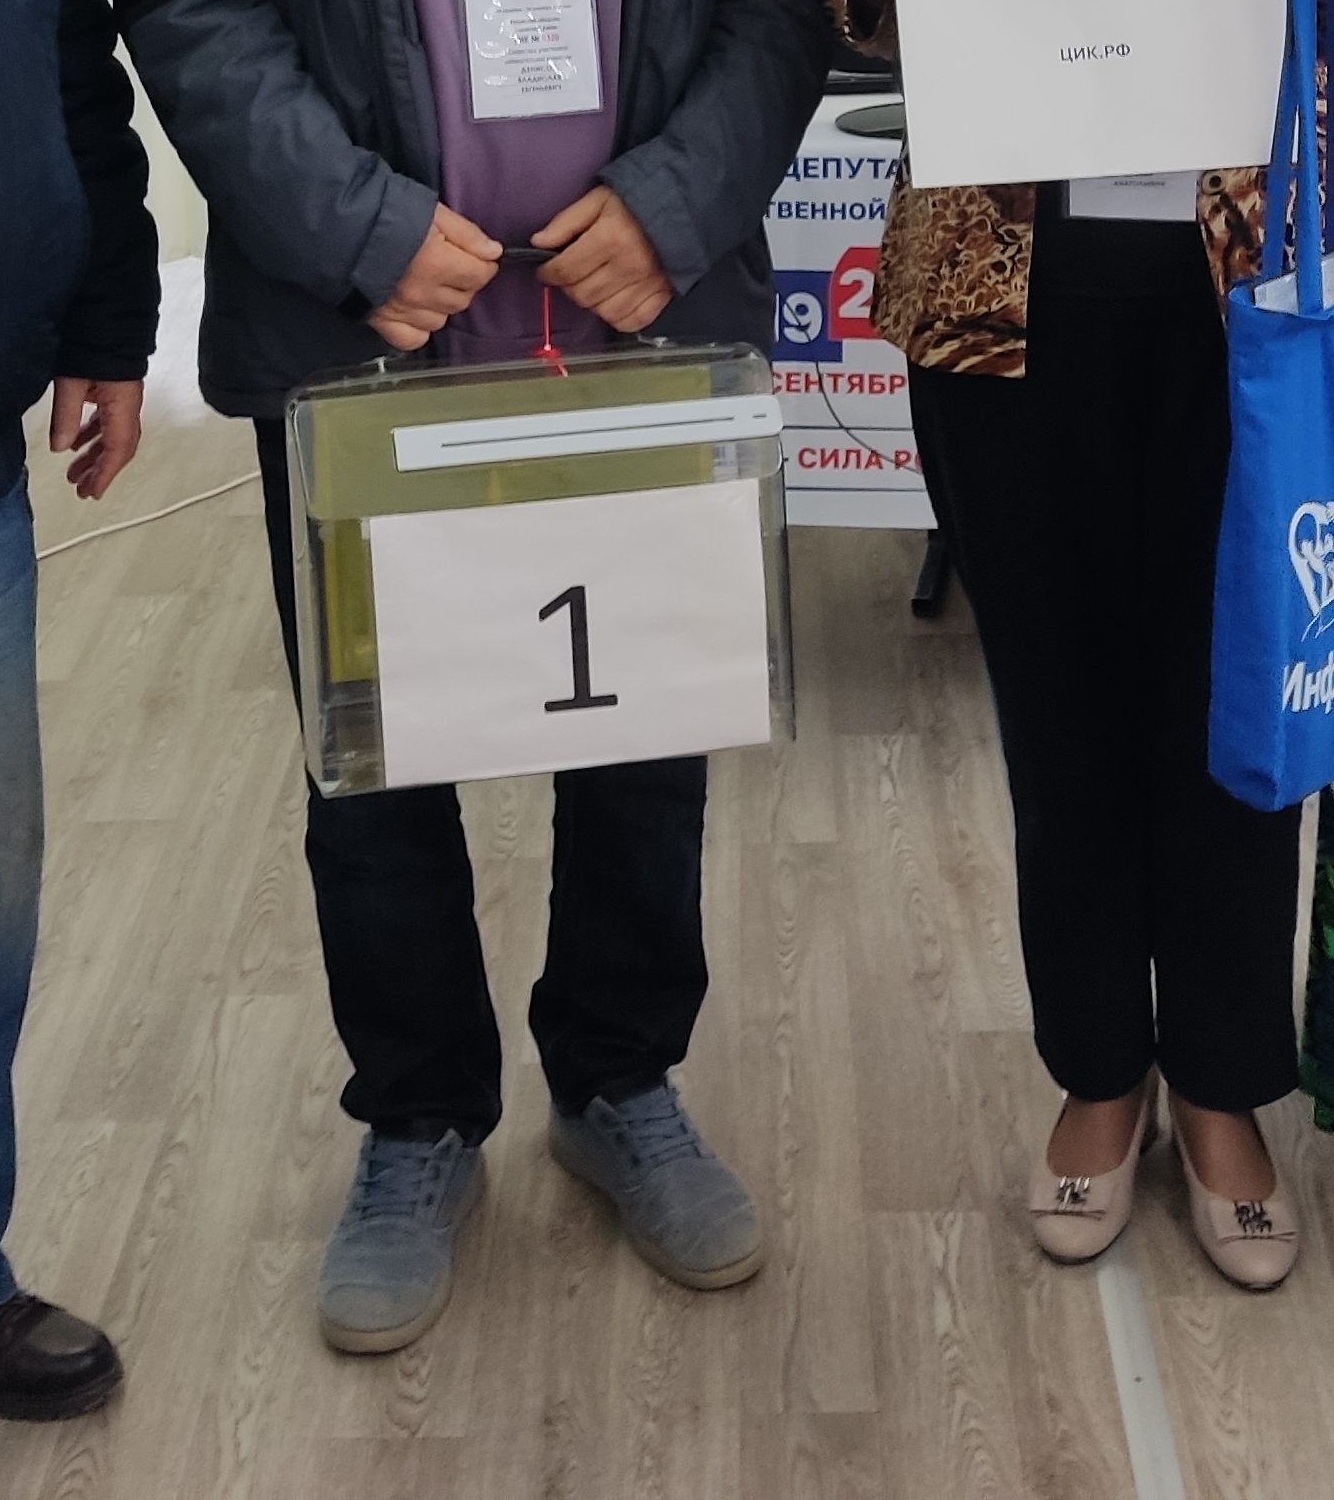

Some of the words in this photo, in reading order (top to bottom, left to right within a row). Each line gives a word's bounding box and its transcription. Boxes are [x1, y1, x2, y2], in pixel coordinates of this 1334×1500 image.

[1060, 43, 1131, 63] ЦИК.РФ
[786, 157, 900, 182] ДЕПУТА
[839, 266, 875, 319] 2
[798, 447, 883, 470] СИЛА
[537, 585, 619, 714] 1
